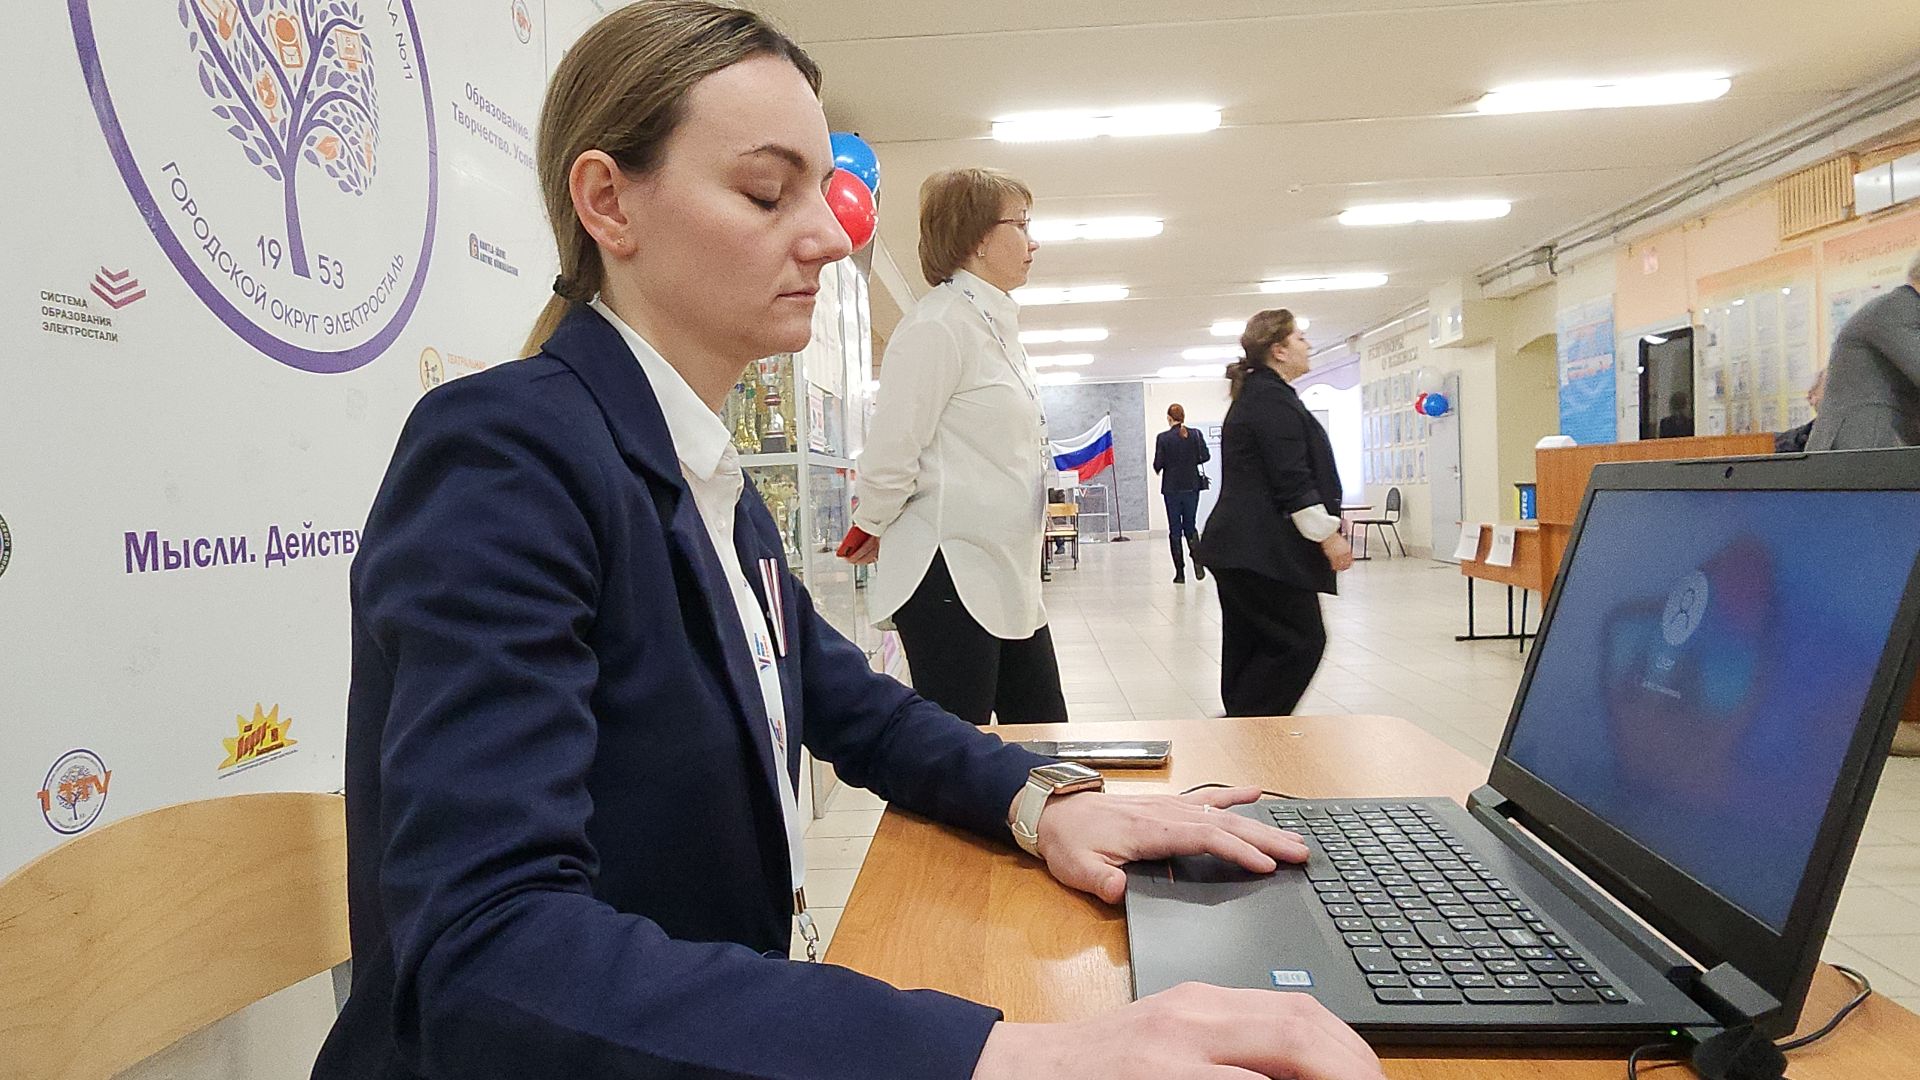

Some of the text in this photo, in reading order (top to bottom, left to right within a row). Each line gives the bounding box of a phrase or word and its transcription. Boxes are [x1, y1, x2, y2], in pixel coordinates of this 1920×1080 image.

[452, 101, 512, 156] Творчество.
[465, 82, 531, 142] Образование.
[161, 161, 404, 336] ГОРОДСКОЙ ОКРУГ ЭЛЕКТРОСТАЛЬ
[257, 235, 345, 290] 19 53
[40, 290, 89, 309] СИСТЕМА
[41, 305, 113, 327] ОБРАЗОВАНИЯ
[41, 321, 119, 343] ЭЛЕКТРОСТАЛИ
[123, 530, 257, 574] Мысли.
